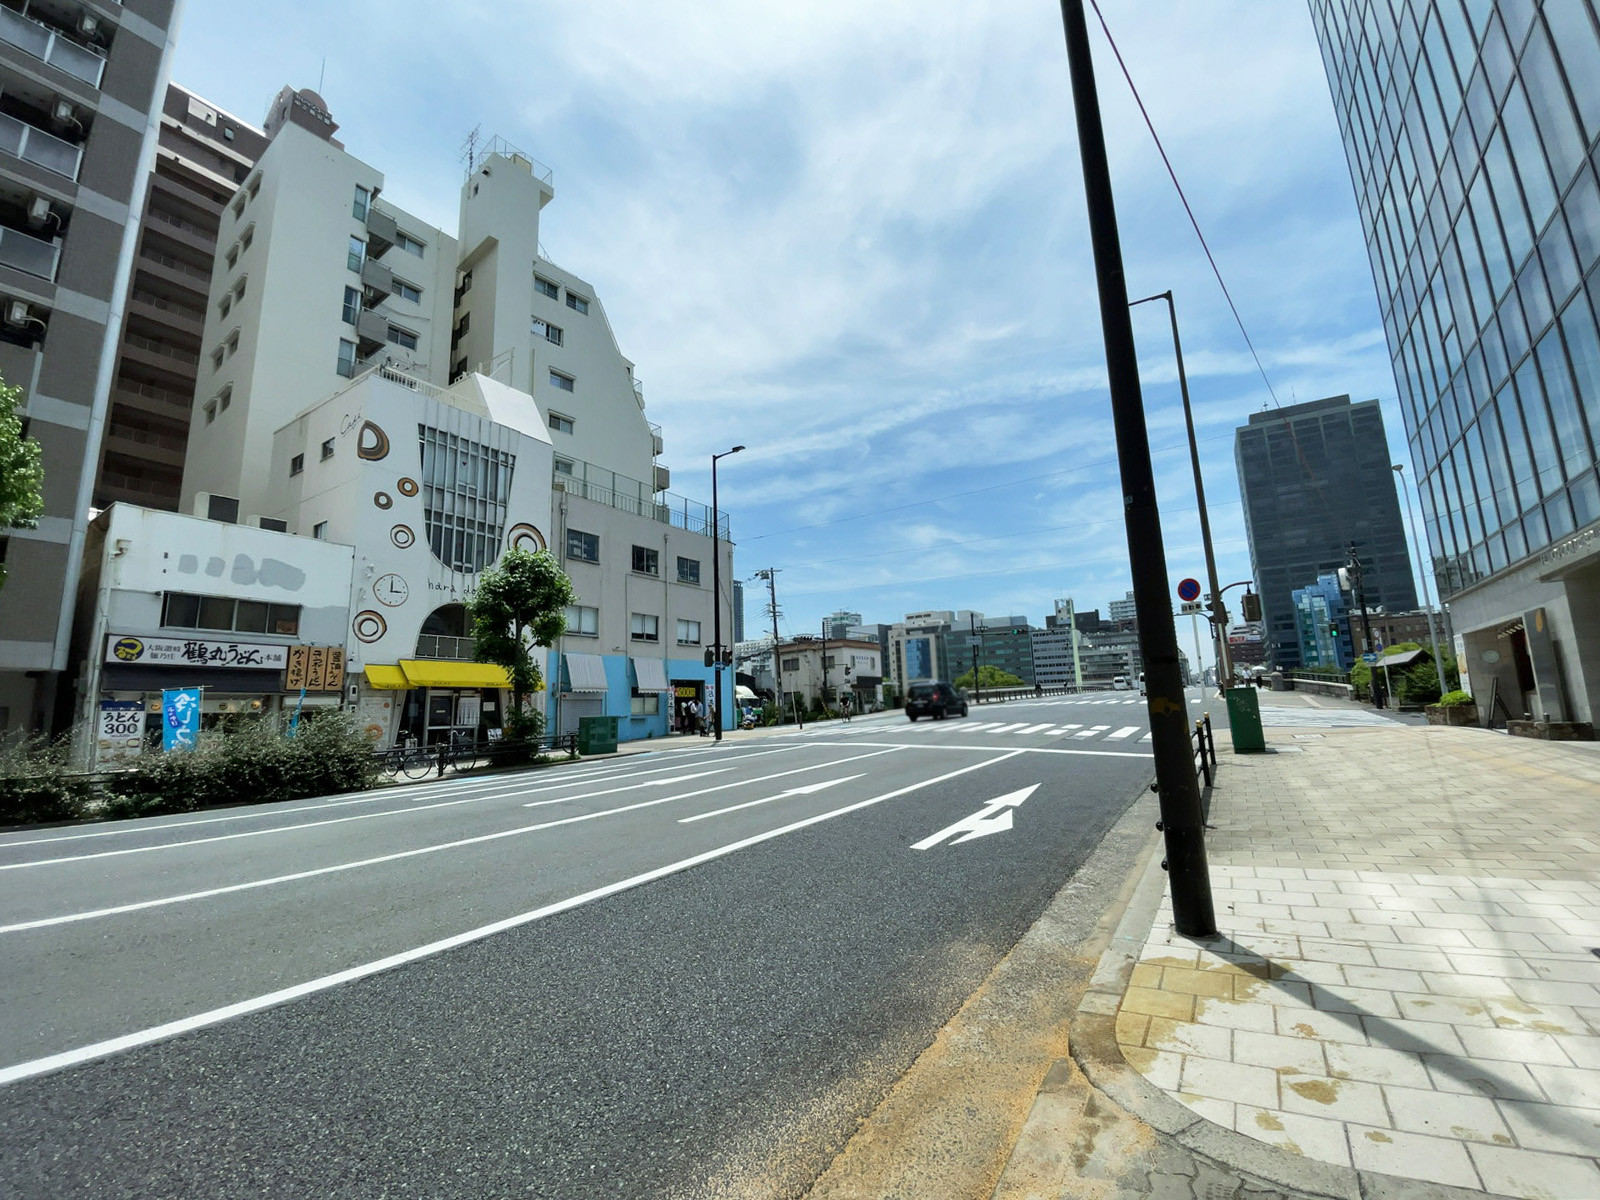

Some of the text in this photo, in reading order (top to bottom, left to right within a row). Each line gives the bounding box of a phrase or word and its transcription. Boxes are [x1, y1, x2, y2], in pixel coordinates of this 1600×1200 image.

[103, 711, 141, 723] うどん
[104, 723, 138, 734] 300
